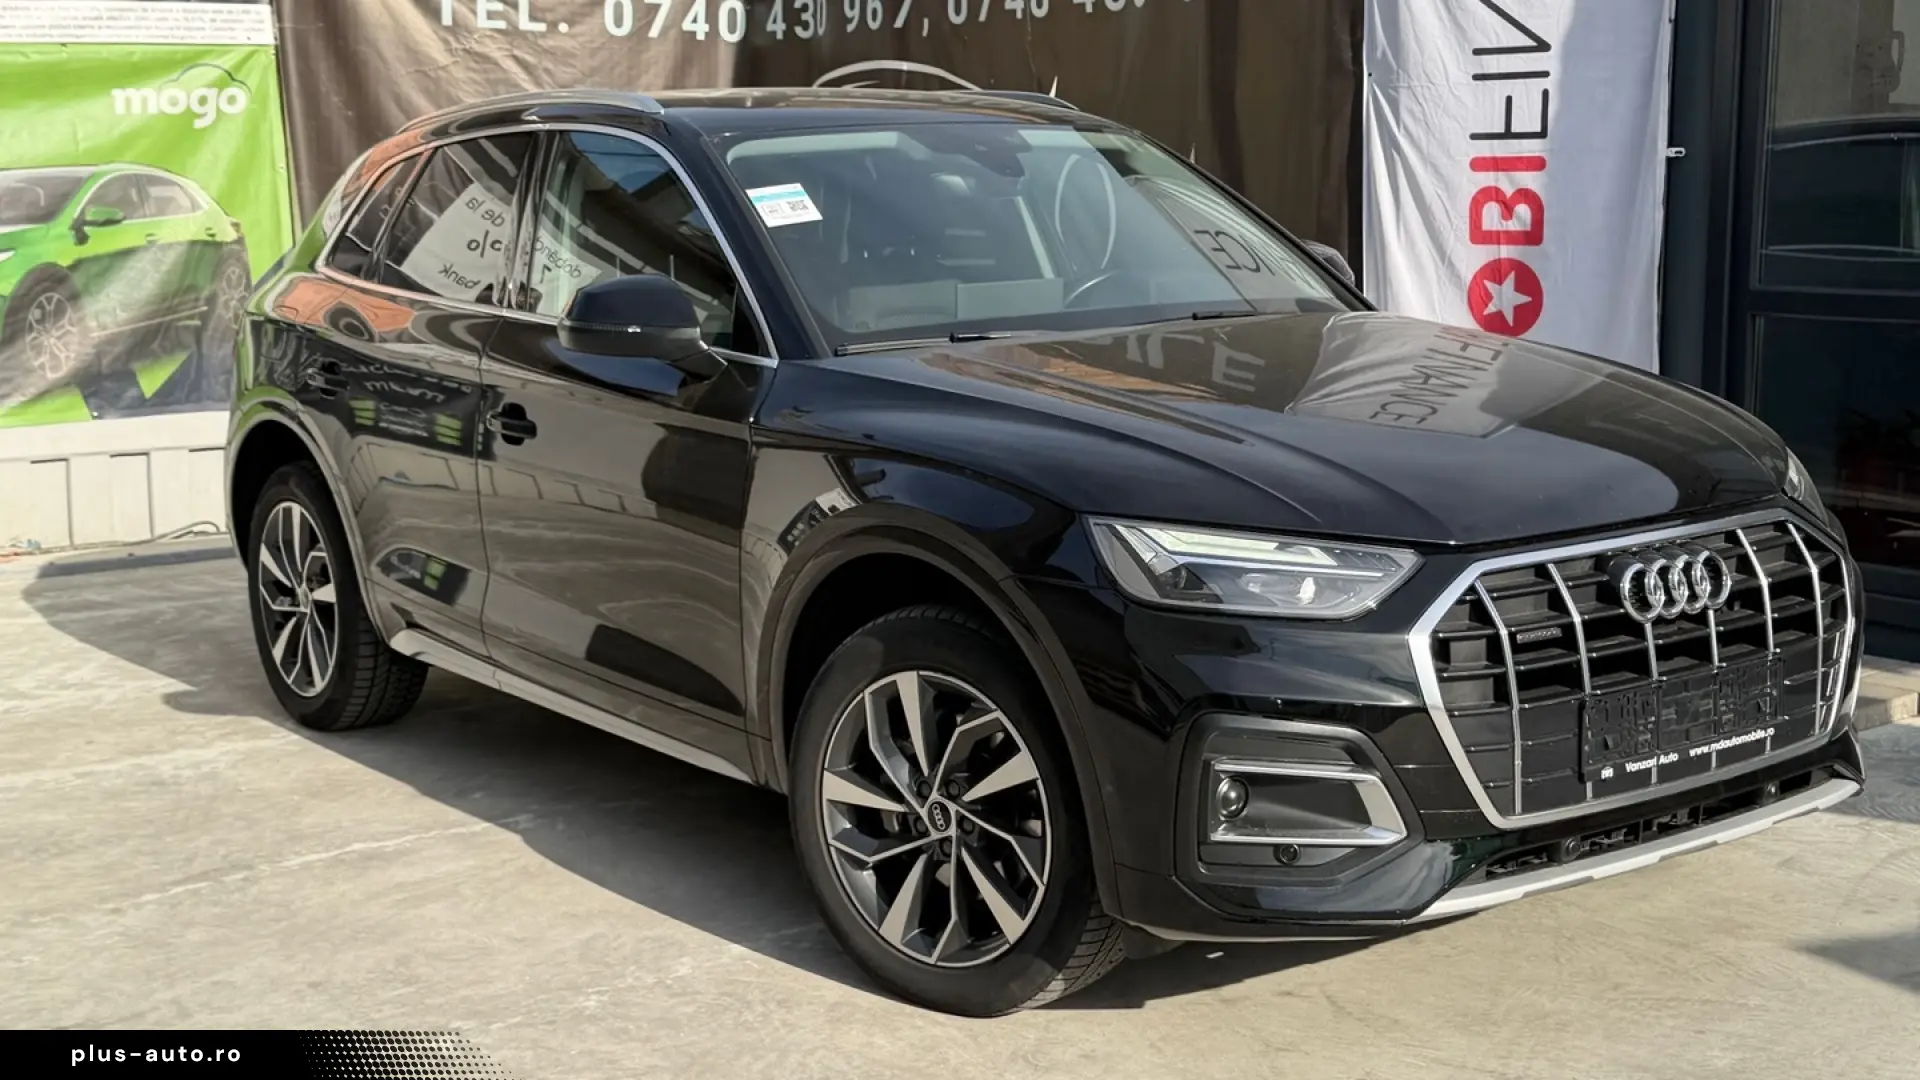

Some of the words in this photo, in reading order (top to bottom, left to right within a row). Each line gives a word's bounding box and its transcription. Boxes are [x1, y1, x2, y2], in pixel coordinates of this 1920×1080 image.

[603, 0, 748, 43] 0740
[766, 0, 826, 39] 430
[110, 86, 248, 129] mogo
[1658, 751, 1679, 765] Auto
